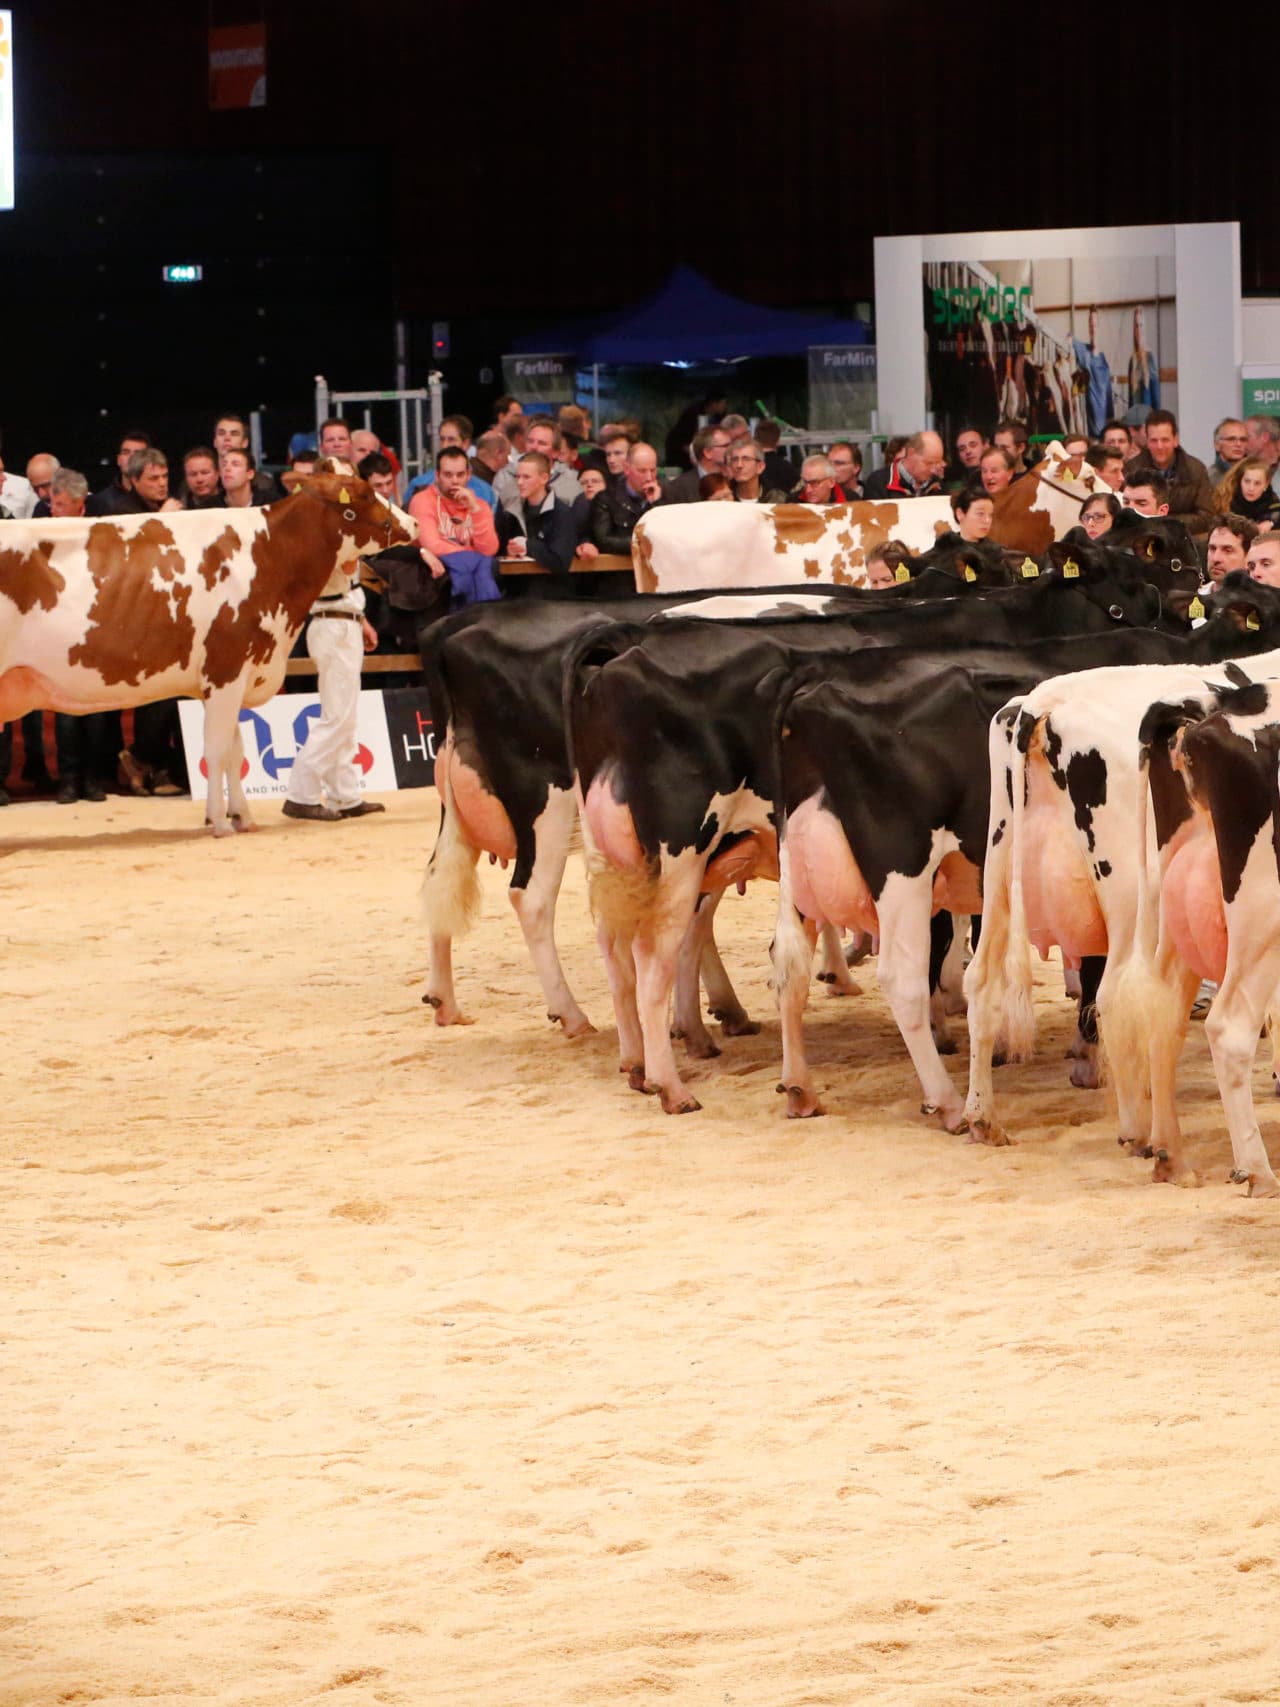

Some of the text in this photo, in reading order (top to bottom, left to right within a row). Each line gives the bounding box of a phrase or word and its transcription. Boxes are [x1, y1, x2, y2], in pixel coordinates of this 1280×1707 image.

[933, 272, 1031, 334] spinder
[515, 359, 563, 376] FarMin
[824, 352, 875, 367] FarMin
